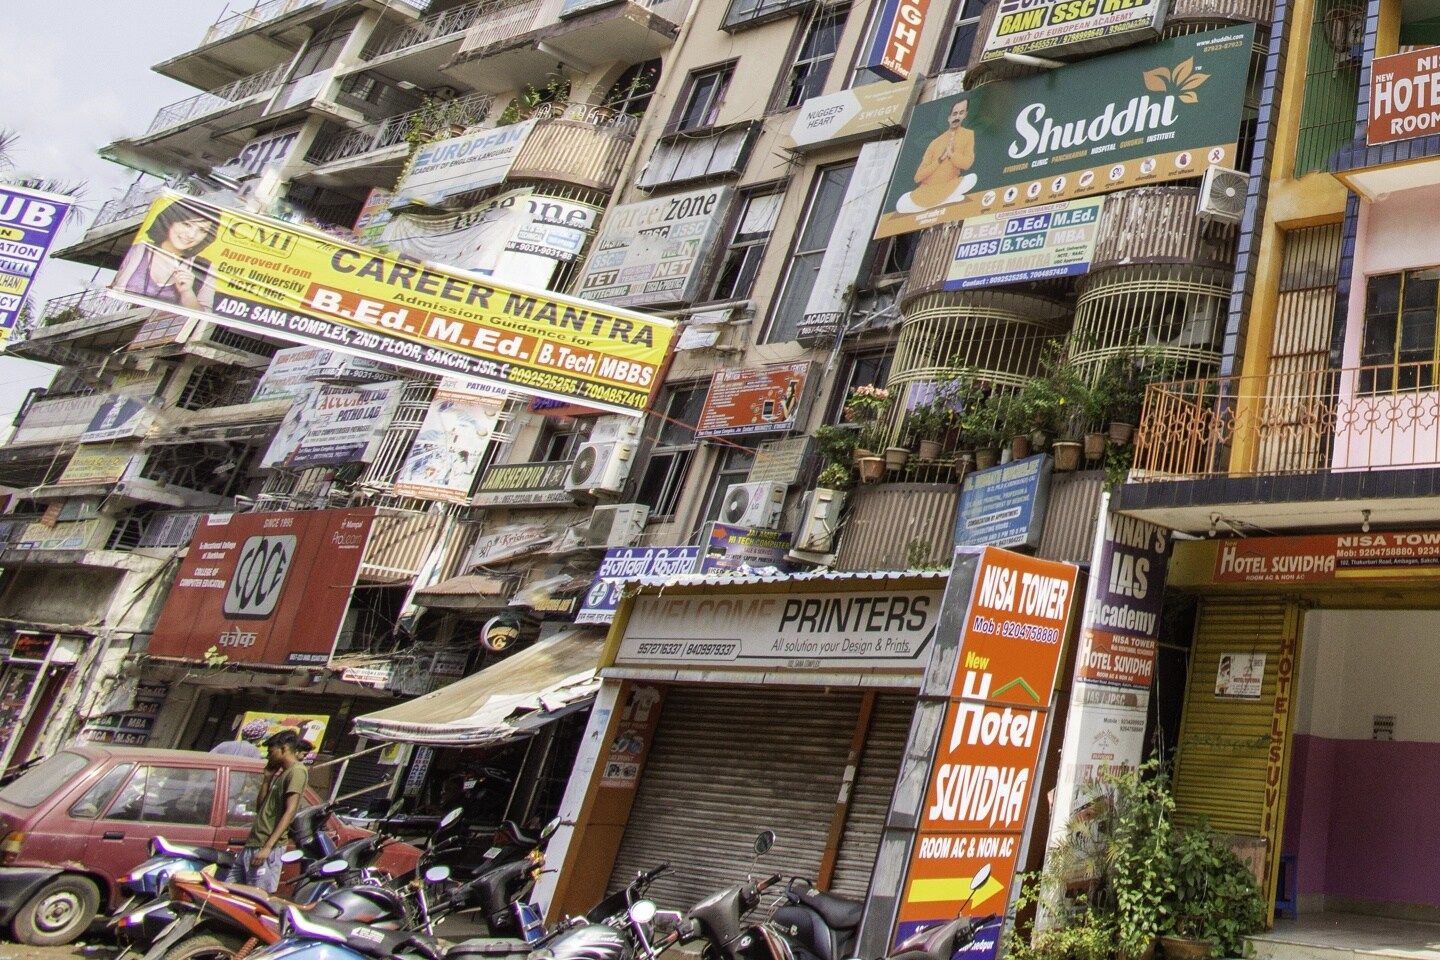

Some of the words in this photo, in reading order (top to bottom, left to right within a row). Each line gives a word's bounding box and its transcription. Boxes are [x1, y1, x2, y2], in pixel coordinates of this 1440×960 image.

[999, 10, 1046, 36] BANK
[1012, 32, 1031, 43] UNIT
[1034, 30, 1045, 39] OF
[1046, 21, 1090, 37] EUROPEAN
[1092, 12, 1134, 28] ACADEMY
[1196, 34, 1244, 47] www.shuddhi.com
[883, 56, 895, 70] 3rd
[895, 61, 909, 76] Floor
[1375, 72, 1394, 83] NEW
[806, 105, 844, 120] NUGGETS
[859, 105, 898, 120] SWIGGY
[807, 116, 836, 128] HEART
[1008, 95, 1179, 159] Shuddhi
[228, 221, 293, 252] CMI
[962, 224, 1003, 239] B.Ed.
[1006, 217, 1048, 232] D.Ed.
[1053, 209, 1095, 226] M.Ed.
[957, 241, 997, 259] MBBS
[1002, 236, 1044, 251] B.Tech
[1054, 229, 1085, 243] MBA
[220, 248, 281, 271] Approved
[282, 263, 312, 279] from
[585, 272, 618, 287] TET
[655, 261, 690, 277] NET
[331, 248, 495, 310] CAREER
[504, 293, 653, 348] MANTRA
[392, 292, 487, 322] Admission
[490, 316, 566, 342] Guidance
[571, 336, 594, 348] for
[311, 288, 415, 334] B.Ed.
[427, 316, 529, 361] M.Ed.
[537, 342, 594, 374] B.Tech
[598, 356, 653, 387] MBBS
[216, 298, 250, 318] ADD:
[251, 305, 287, 327] SANA
[289, 316, 352, 340] COMPLEX,
[353, 331, 380, 349] 2ND
[380, 337, 422, 361] FLOOR,
[425, 348, 471, 369] SAKCHI,
[473, 360, 498, 376] JSR.
[509, 367, 577, 393] 8092525255
[585, 382, 648, 409] 7004857410
[482, 466, 545, 489] JAMSHEDPUR
[263, 519, 279, 527] SINCE
[280, 518, 293, 527] 1995
[1107, 512, 1168, 554] VINAY'S
[1337, 536, 1387, 548] NISA
[1108, 551, 1150, 599] IAS
[1220, 544, 1267, 576] HOTEL
[1271, 555, 1336, 575] SUVIDHA
[978, 564, 1018, 612] NISA
[1018, 572, 1069, 620] TOWER
[778, 595, 931, 634] PRINTERS
[1089, 597, 1156, 635] Academy
[219, 626, 258, 648] कोक
[771, 638, 783, 652] All
[784, 639, 818, 653] solution
[820, 642, 840, 655] your
[841, 639, 873, 655] Design
[874, 640, 883, 652] &
[885, 640, 911, 654] Prints.
[1002, 620, 1060, 643] 9204758880
[637, 642, 682, 655] 9572716337
[686, 643, 736, 657] 8409979337
[949, 670, 1038, 754] Hotel
[929, 764, 1029, 828] SUVIDHA
[918, 837, 950, 859] ROOM
[950, 839, 966, 858] AC
[967, 838, 975, 858] &
[977, 838, 998, 858] NON
[999, 839, 1013, 858] AC
